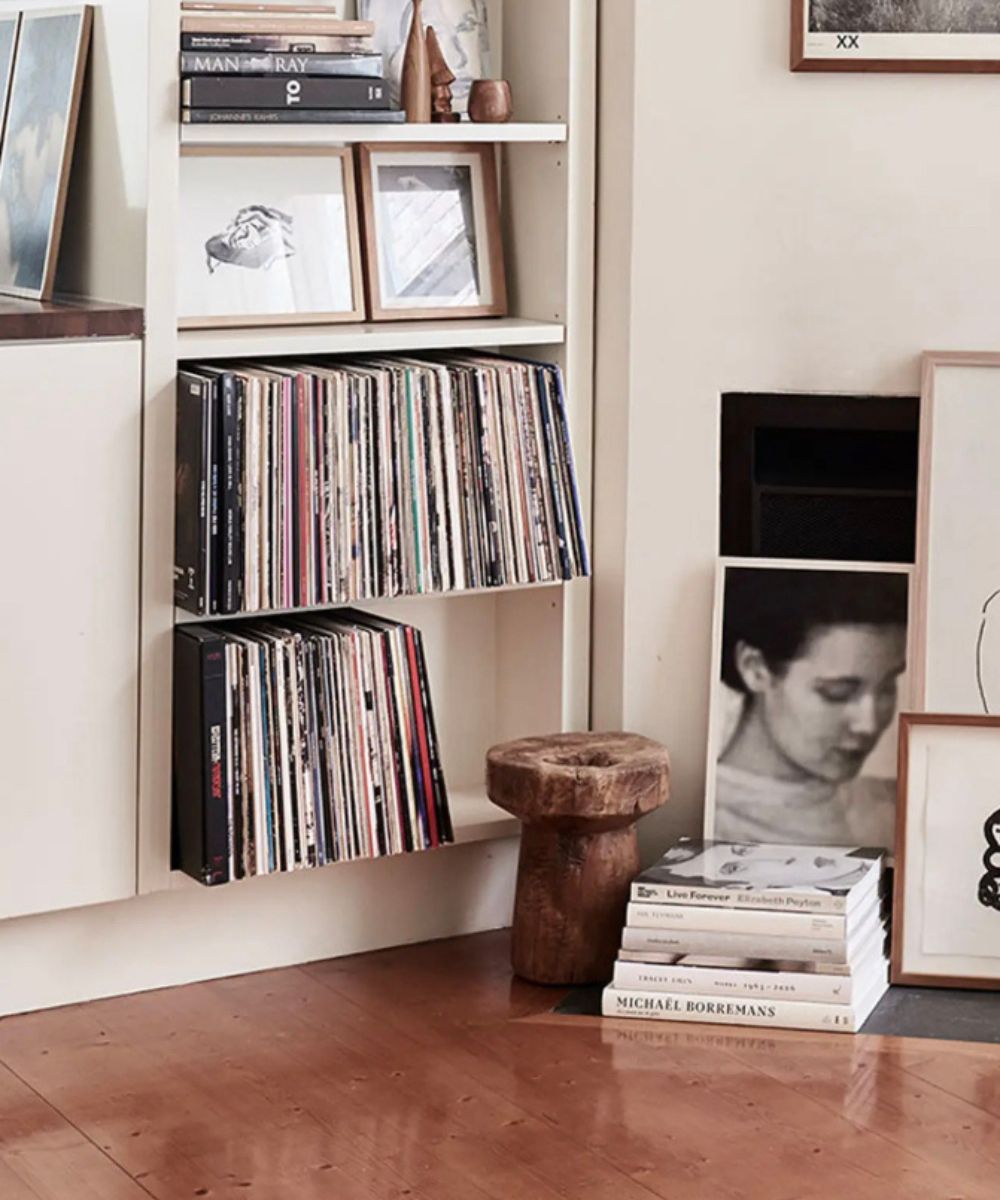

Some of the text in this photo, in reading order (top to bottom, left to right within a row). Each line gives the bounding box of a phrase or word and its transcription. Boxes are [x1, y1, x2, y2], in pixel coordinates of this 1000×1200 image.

[836, 35, 860, 49] XX
[193, 56, 309, 73] MAN RAY
[286, 80, 301, 105] TO
[667, 889, 688, 899] Live
[689, 890, 731, 902] Forever
[736, 893, 785, 906] Elizabeth
[785, 895, 822, 908] Peyton
[616, 995, 777, 1018] MICHAËL BORREMANS
